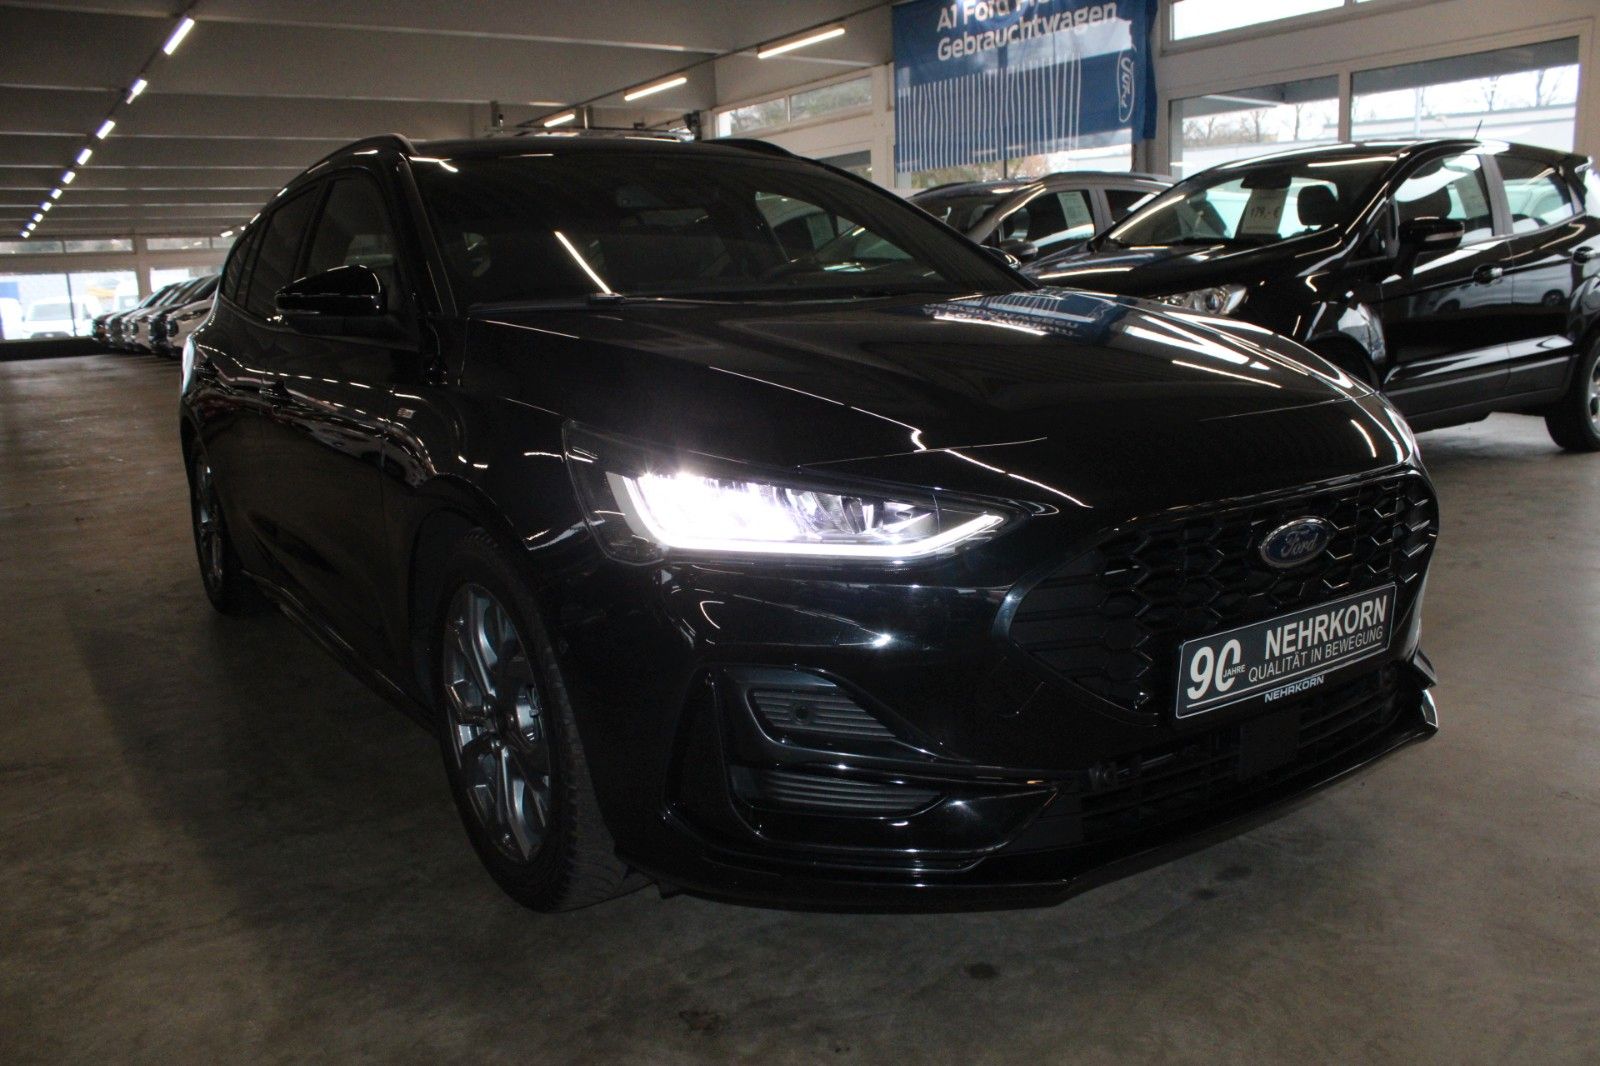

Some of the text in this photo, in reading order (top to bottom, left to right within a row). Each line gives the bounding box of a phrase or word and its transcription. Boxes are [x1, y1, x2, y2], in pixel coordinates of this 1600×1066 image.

[937, 2, 1117, 61] Gebrauchtwagen
[1281, 529, 1319, 558] Ford
[1248, 626, 1383, 683] QUALITÄT IN BEWEGUNG
[1265, 595, 1387, 660] NEHRKORN
[1187, 639, 1241, 700] 90
[1222, 664, 1246, 678] JAHRE
[1264, 675, 1325, 703] NEHRKORN
